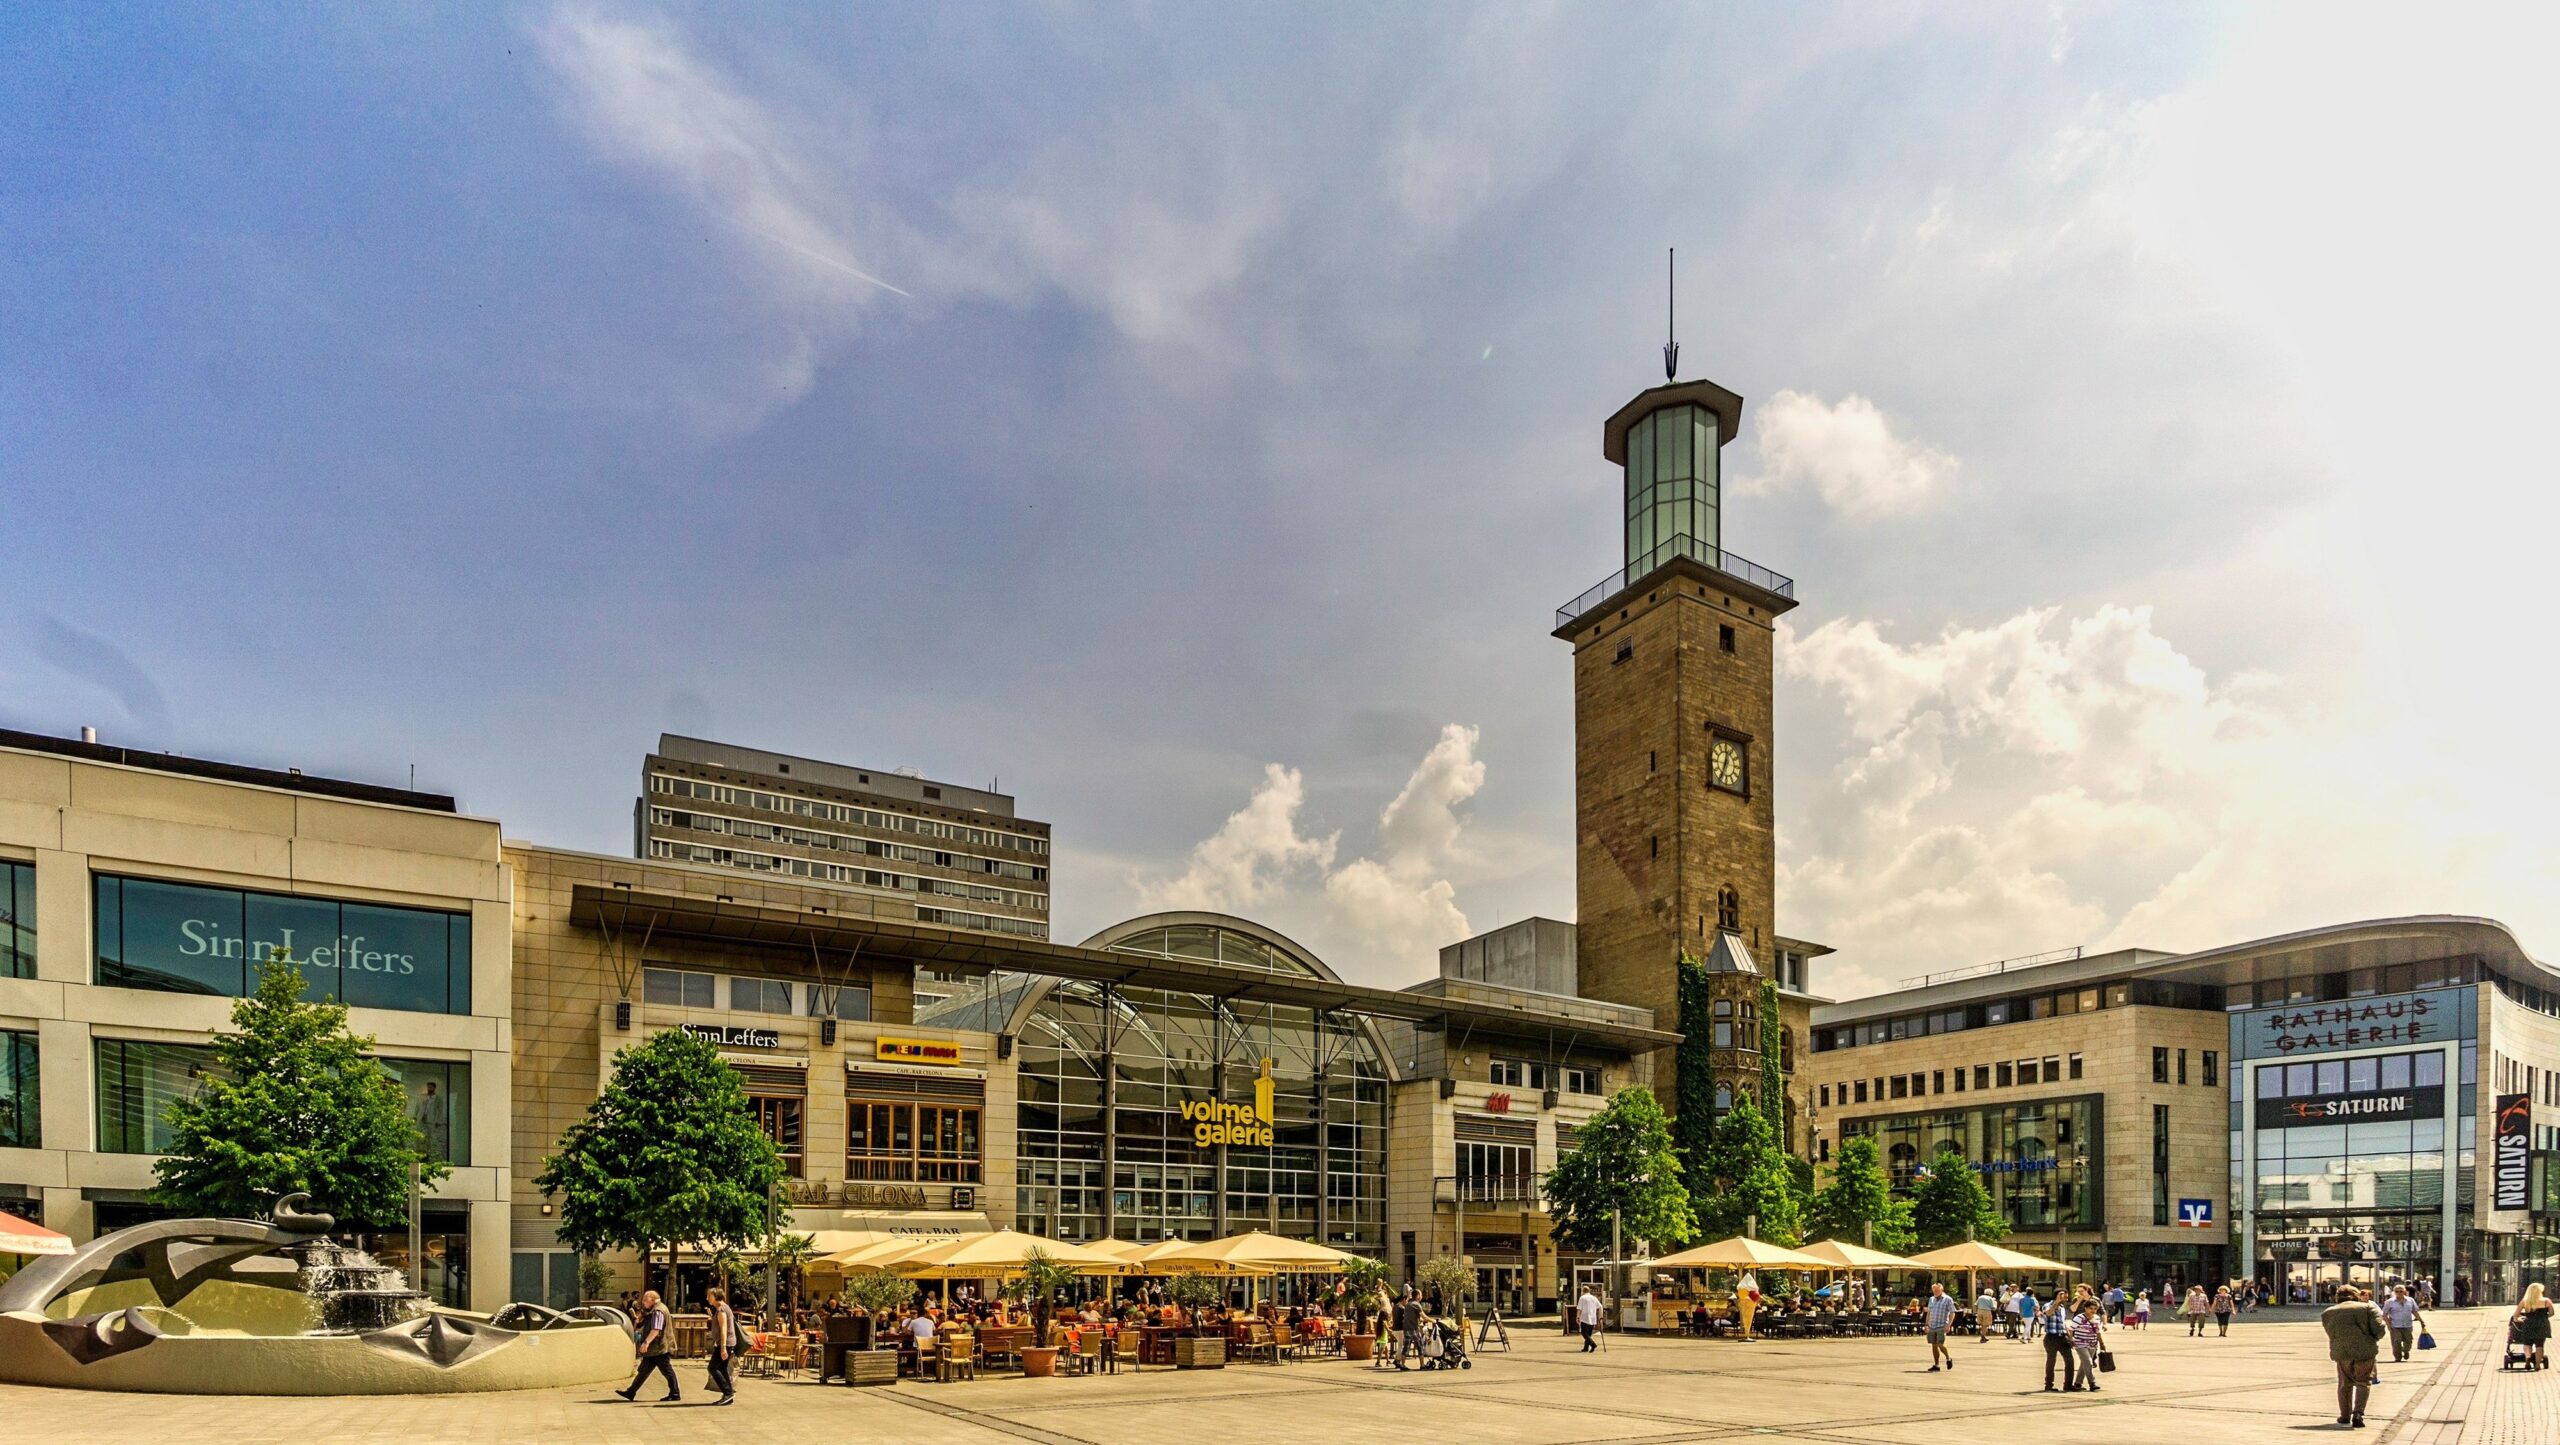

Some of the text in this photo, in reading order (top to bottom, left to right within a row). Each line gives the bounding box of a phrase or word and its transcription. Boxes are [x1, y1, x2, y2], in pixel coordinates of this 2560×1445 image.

[179, 919, 415, 975] SinnLeffers
[2271, 998, 2429, 1031] RATHAUS
[2275, 1021, 2422, 1050] GALERIE
[1179, 1096, 1254, 1124] volme
[2326, 1096, 2405, 1116] SATURN
[1194, 1120, 1275, 1147] galerie
[2498, 1134, 2527, 1206] SATURN
[787, 1183, 928, 1204] BAR CELONA
[933, 1227, 960, 1235] BAR
[2354, 1239, 2422, 1253] SATURN
